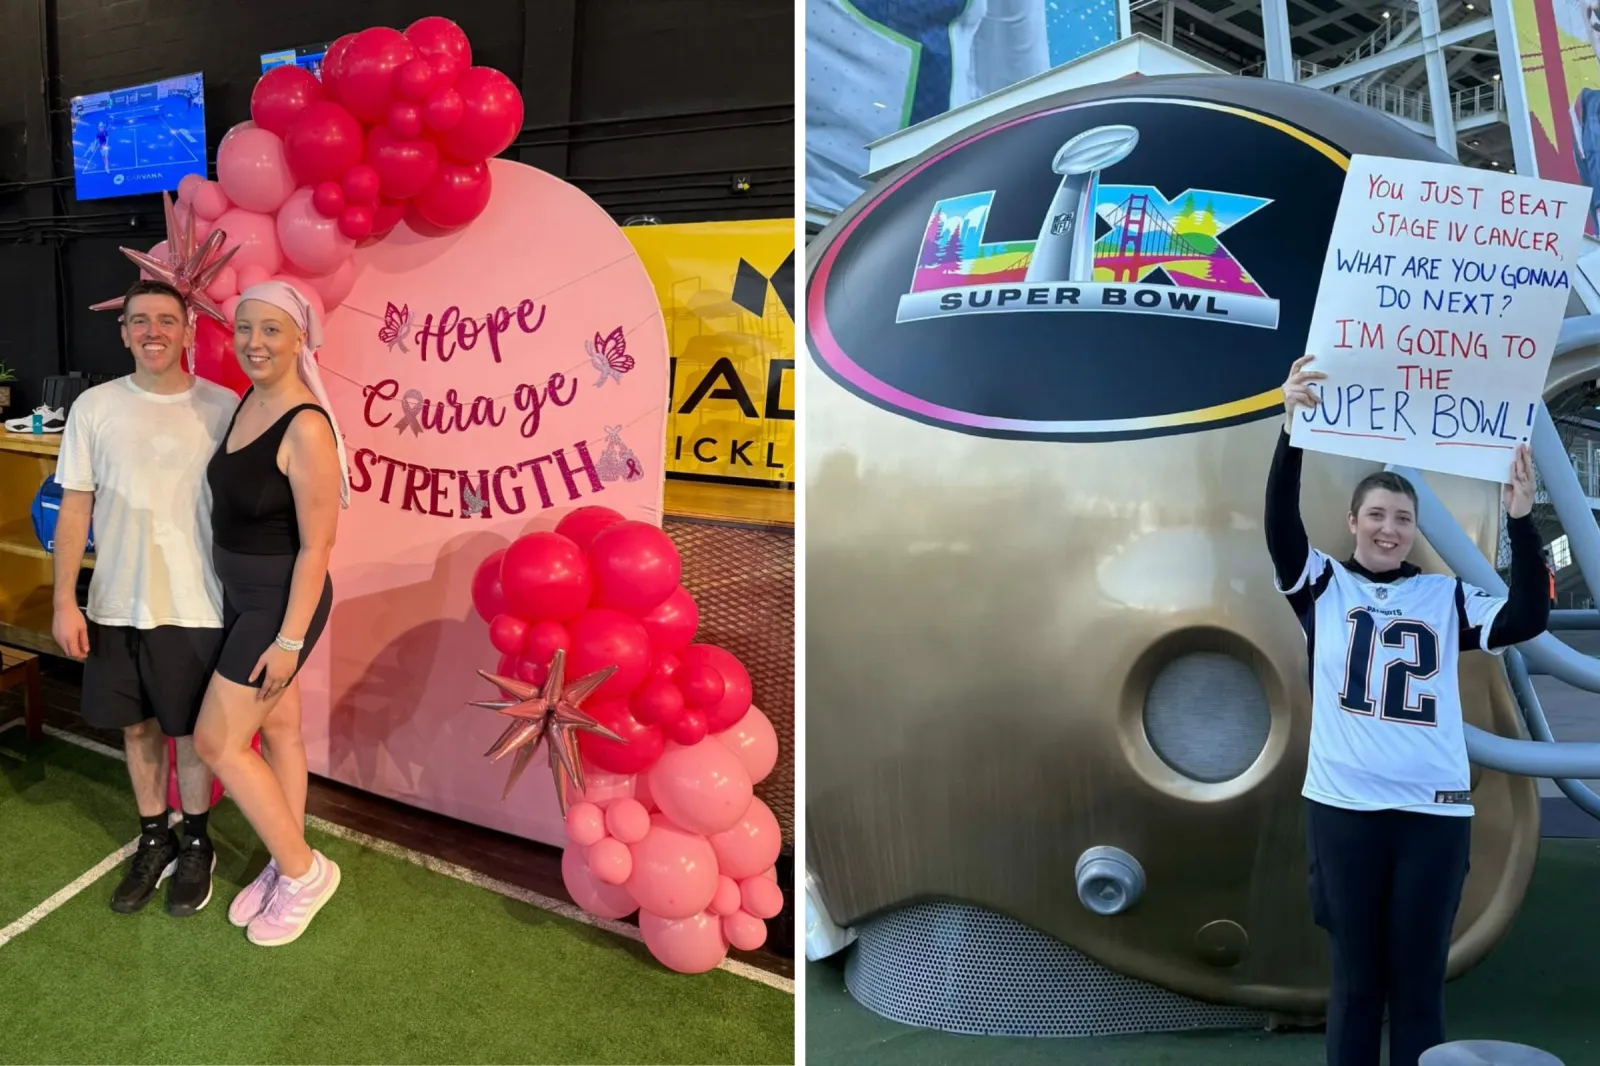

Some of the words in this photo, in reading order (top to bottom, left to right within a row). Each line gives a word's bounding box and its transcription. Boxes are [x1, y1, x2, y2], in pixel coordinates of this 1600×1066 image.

[1420, 181, 1484, 210] JUST
[1500, 190, 1569, 219] BEAT
[1372, 211, 1439, 240] STAGE
[1448, 221, 1468, 242] IV
[1474, 225, 1564, 262] CANCER,
[1336, 248, 1396, 277] WHAT
[1401, 256, 1442, 280] ARE
[1451, 257, 1497, 283] YOU
[1501, 264, 1569, 290] GONNA
[939, 287, 1082, 312] SUPER
[1101, 288, 1229, 316] BOWL
[1376, 285, 1411, 310] DO
[415, 298, 547, 364] Hope
[1333, 318, 1385, 350] I'M
[1396, 324, 1488, 360] GOING
[1502, 334, 1536, 359] TO
[1397, 364, 1453, 392] THE
[1432, 393, 1535, 442] BOWL!
[349, 440, 605, 520] STRENGTH
[1338, 606, 1438, 727] 12
